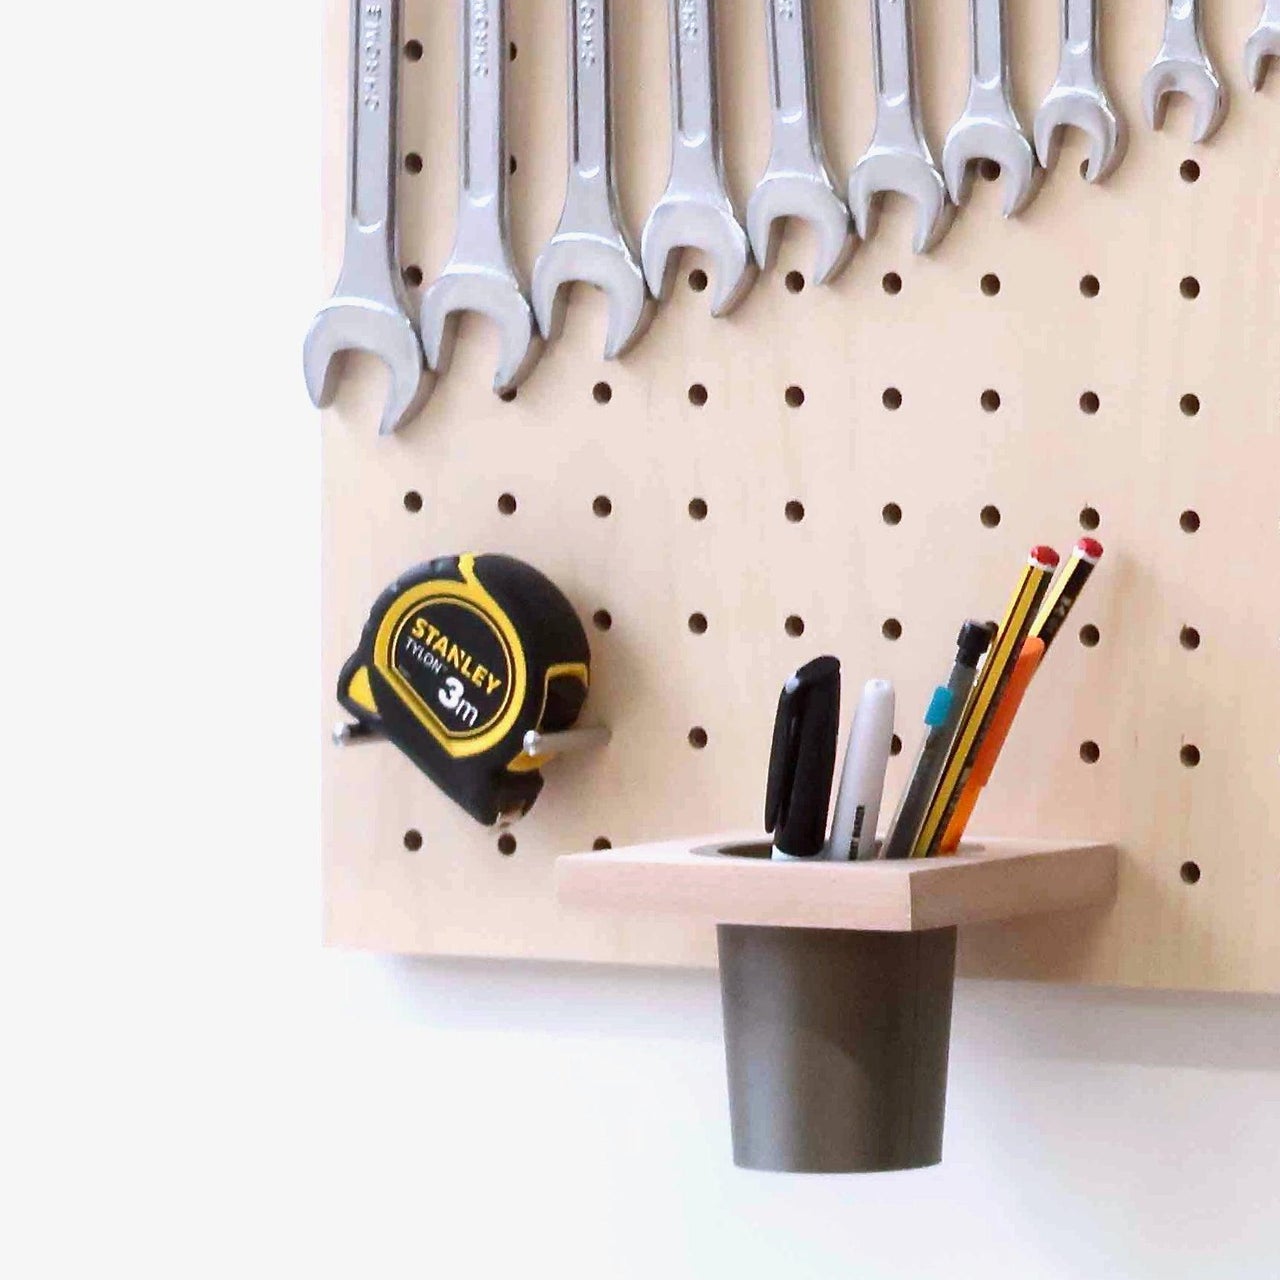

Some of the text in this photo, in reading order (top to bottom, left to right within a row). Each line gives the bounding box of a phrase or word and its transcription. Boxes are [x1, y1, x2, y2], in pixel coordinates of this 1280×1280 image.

[405, 635, 443, 674] TYLON
[411, 617, 502, 695] STANLEY
[438, 676, 479, 728] 3m
